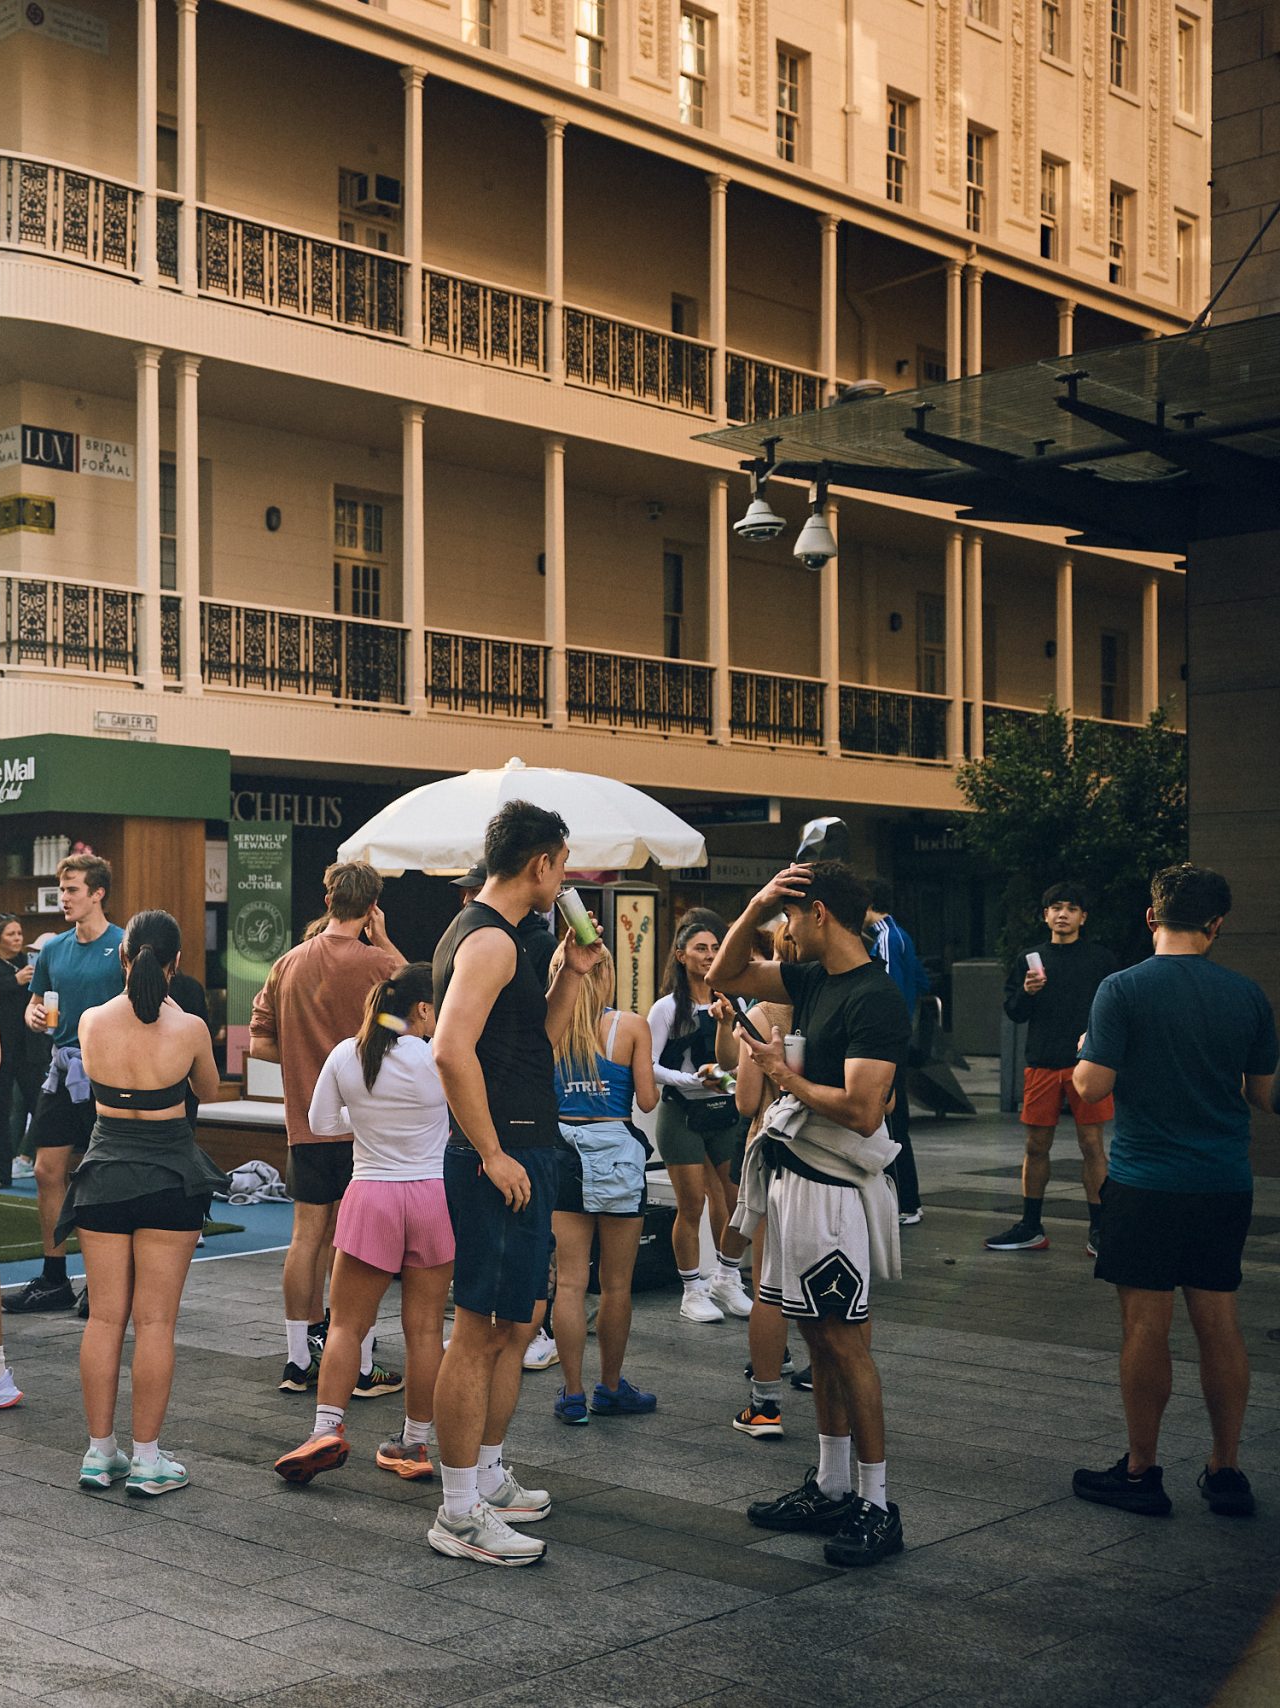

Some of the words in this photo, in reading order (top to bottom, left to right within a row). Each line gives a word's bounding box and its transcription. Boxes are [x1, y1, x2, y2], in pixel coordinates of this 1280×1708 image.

[25, 429, 69, 465] LUV
[85, 440, 128, 457] BRIDAL
[82, 458, 131, 477] FORMAL
[4, 756, 35, 782] Mall
[230, 790, 342, 828] CHELLI'S
[233, 833, 272, 842] SERVING
[275, 833, 287, 842] UP
[238, 881, 282, 890] OCTOBER
